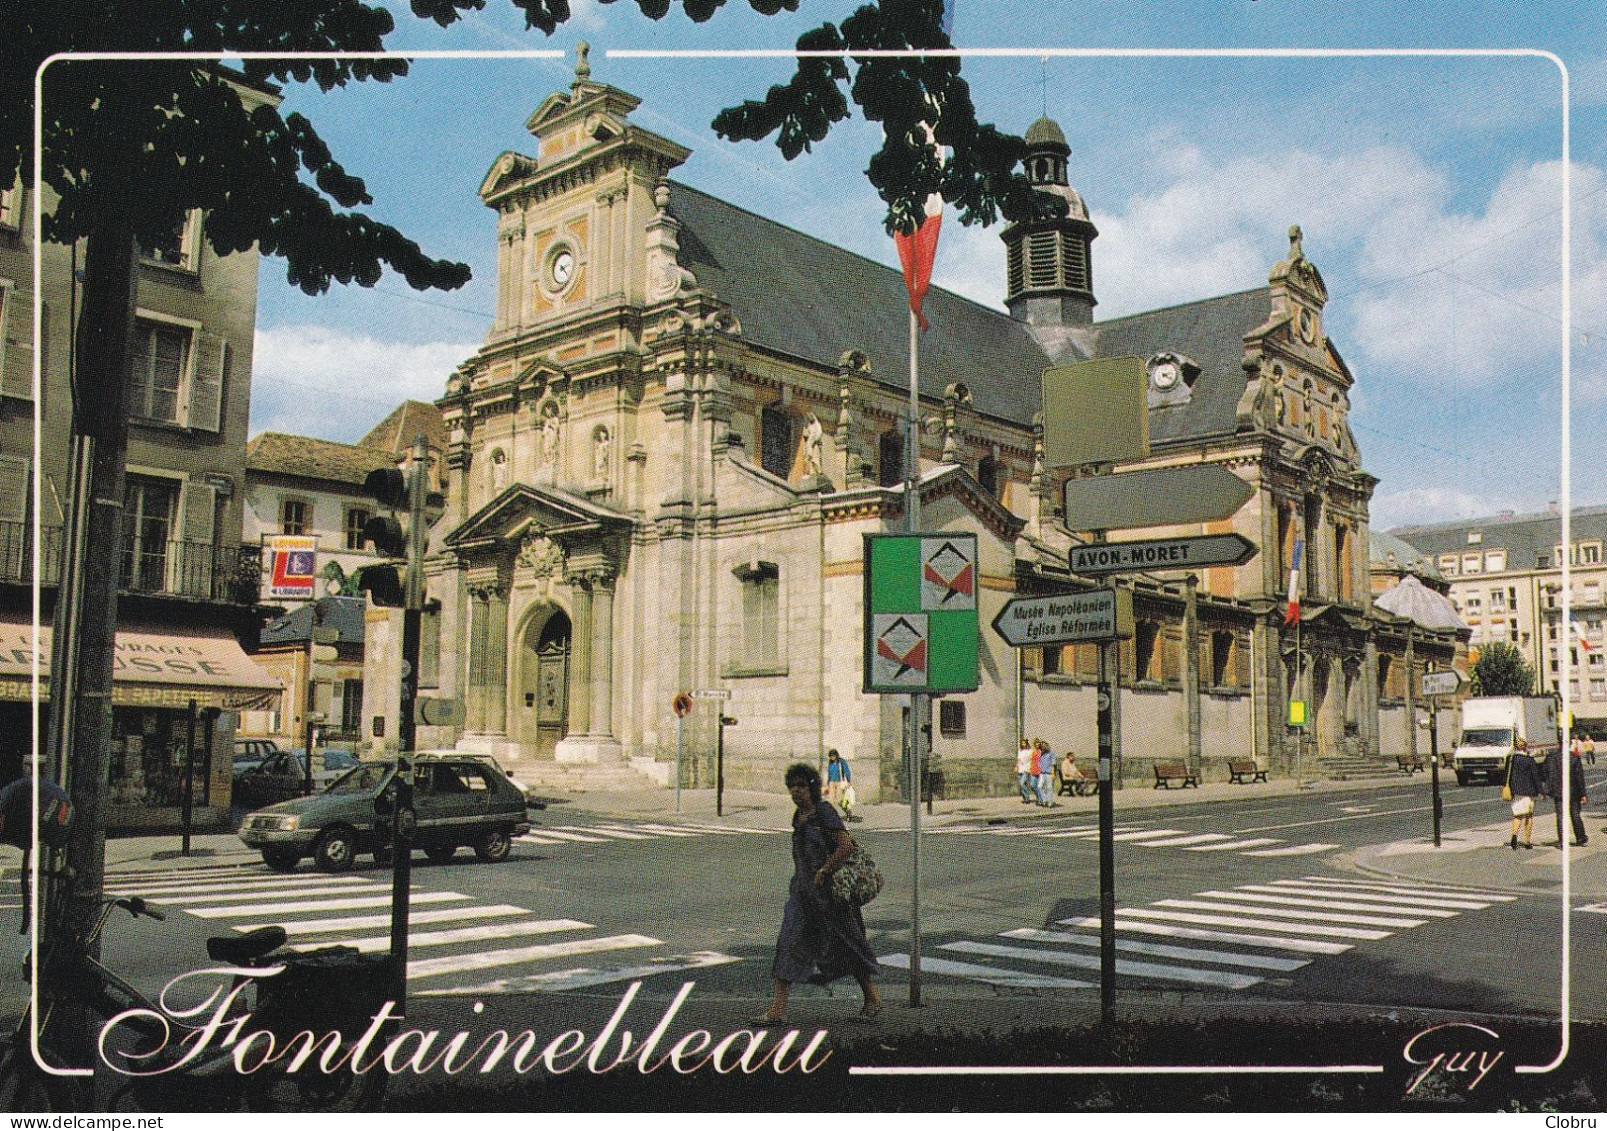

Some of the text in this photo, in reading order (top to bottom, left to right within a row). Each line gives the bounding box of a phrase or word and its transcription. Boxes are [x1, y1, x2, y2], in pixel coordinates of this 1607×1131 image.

[1078, 545, 1190, 567] AVON-MORET
[1013, 599, 1111, 620] Musée Napoléonien
[1027, 617, 1111, 640] Église Réformée
